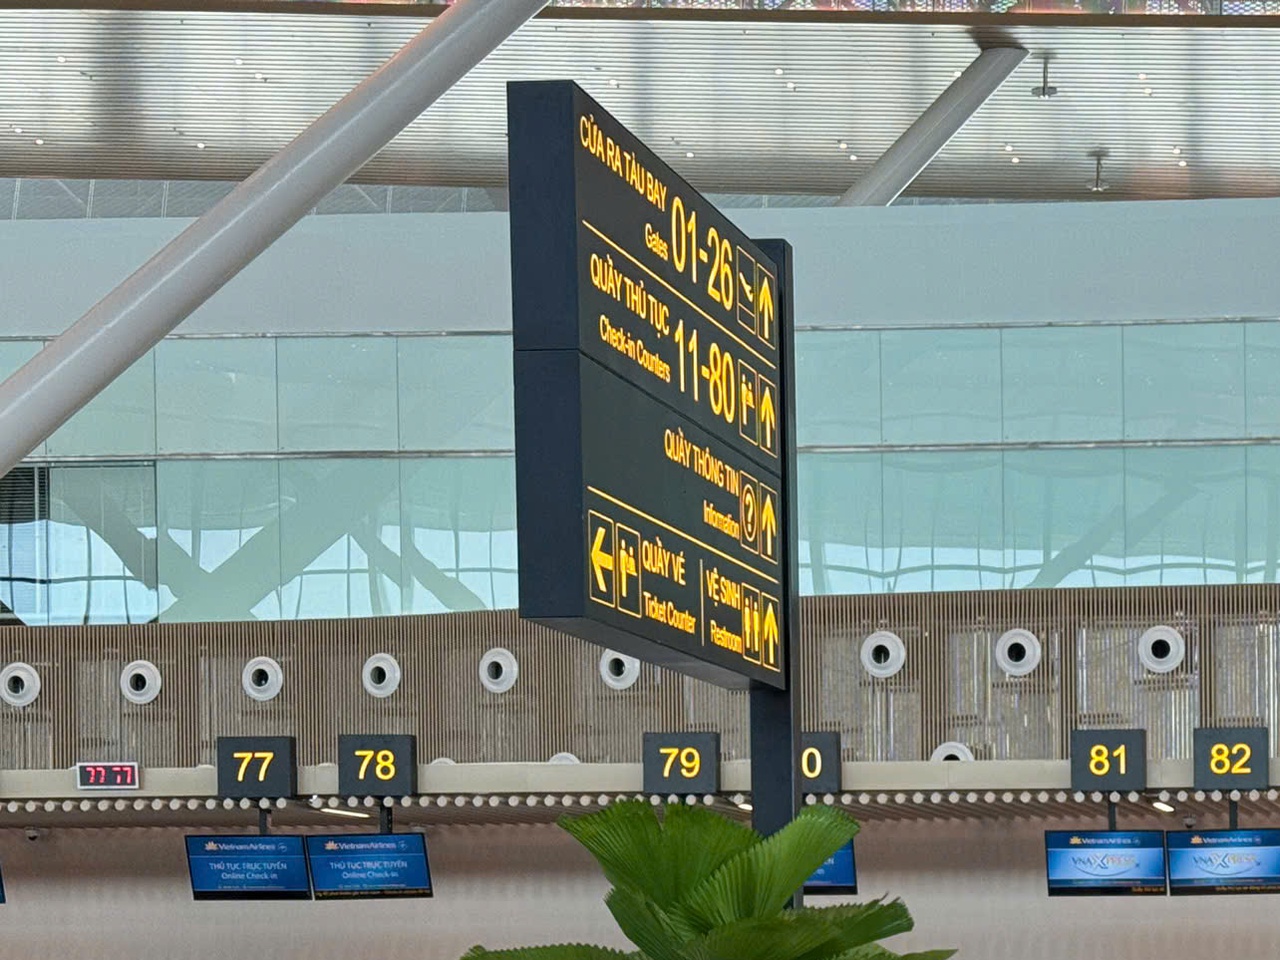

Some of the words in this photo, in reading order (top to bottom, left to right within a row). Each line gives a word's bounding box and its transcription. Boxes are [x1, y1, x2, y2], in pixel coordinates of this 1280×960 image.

[579, 113, 605, 163] CỬA
[606, 136, 623, 178] RA
[623, 151, 645, 196] TÀU
[646, 171, 668, 212] BAY
[645, 222, 670, 261] Gates
[671, 195, 734, 312] 01-26
[590, 252, 623, 302] QUẦY
[623, 277, 647, 320] THỦ
[648, 294, 670, 340] TỤC
[600, 313, 637, 361] Check-in
[636, 338, 671, 384] Counters
[674, 318, 736, 424] 11-80
[664, 426, 692, 469] QUẦY
[692, 445, 725, 488] THÔNG
[724, 463, 740, 498] TIN
[703, 499, 740, 541] Information
[642, 535, 671, 579] QUẦY
[671, 550, 687, 586] VÉ
[706, 566, 720, 608] VỆ
[720, 576, 741, 611] SINH
[642, 590, 668, 624] Ticket
[667, 601, 697, 635] Counter
[710, 619, 743, 654] Restroom
[233, 751, 274, 783] 77
[354, 749, 397, 781] 78
[659, 746, 701, 779] 79
[801, 747, 822, 779] 0
[1089, 744, 1127, 776] 81
[1209, 743, 1252, 775] 82
[221, 871, 245, 880] Online
